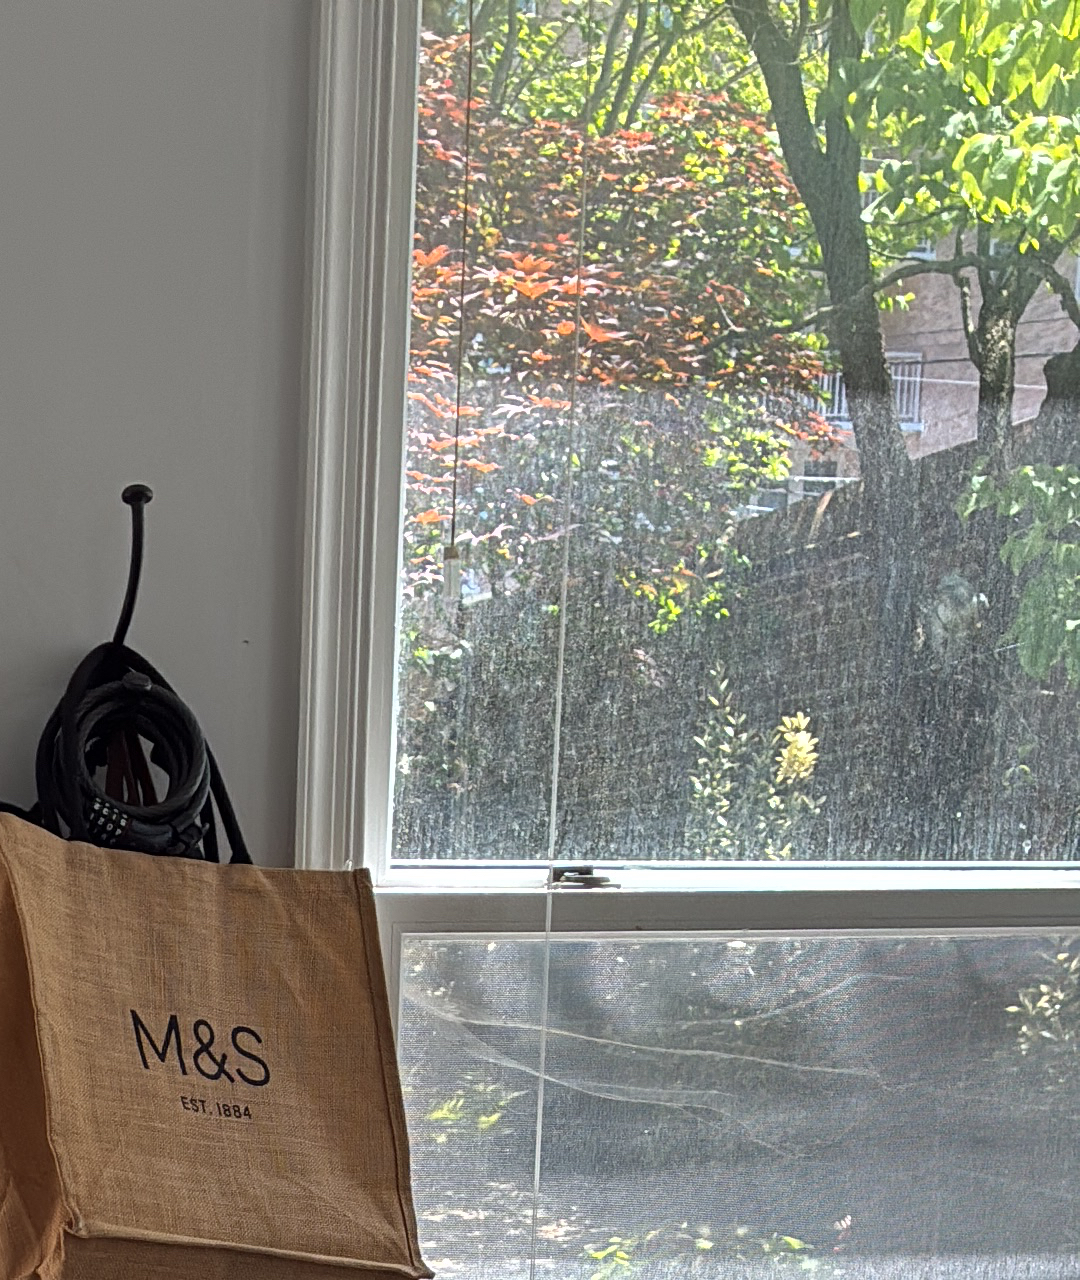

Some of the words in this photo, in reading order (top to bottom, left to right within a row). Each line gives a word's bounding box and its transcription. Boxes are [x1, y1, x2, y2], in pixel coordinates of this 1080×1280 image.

[130, 1009, 271, 1087] M&S
[180, 1095, 213, 1116] EST.
[217, 1102, 252, 1120] 1884
